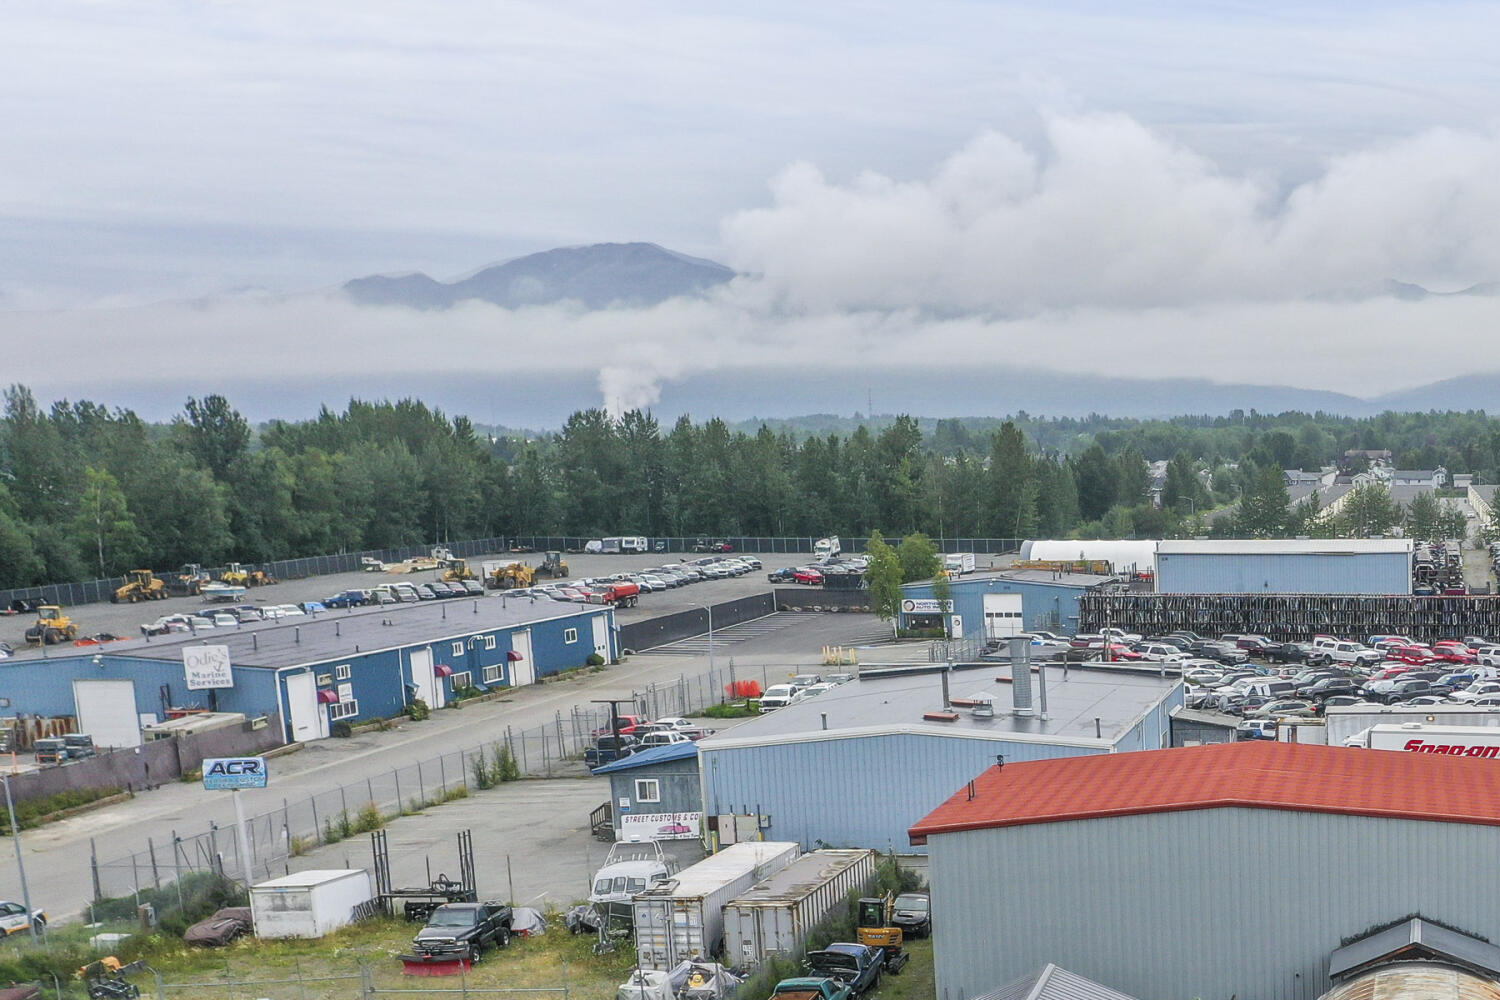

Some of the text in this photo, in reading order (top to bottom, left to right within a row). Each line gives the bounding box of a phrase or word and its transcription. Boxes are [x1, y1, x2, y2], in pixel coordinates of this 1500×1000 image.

[192, 671, 226, 679] Marine
[190, 678, 230, 687] Services
[208, 761, 260, 776] ACR
[625, 815, 649, 823] STREET
